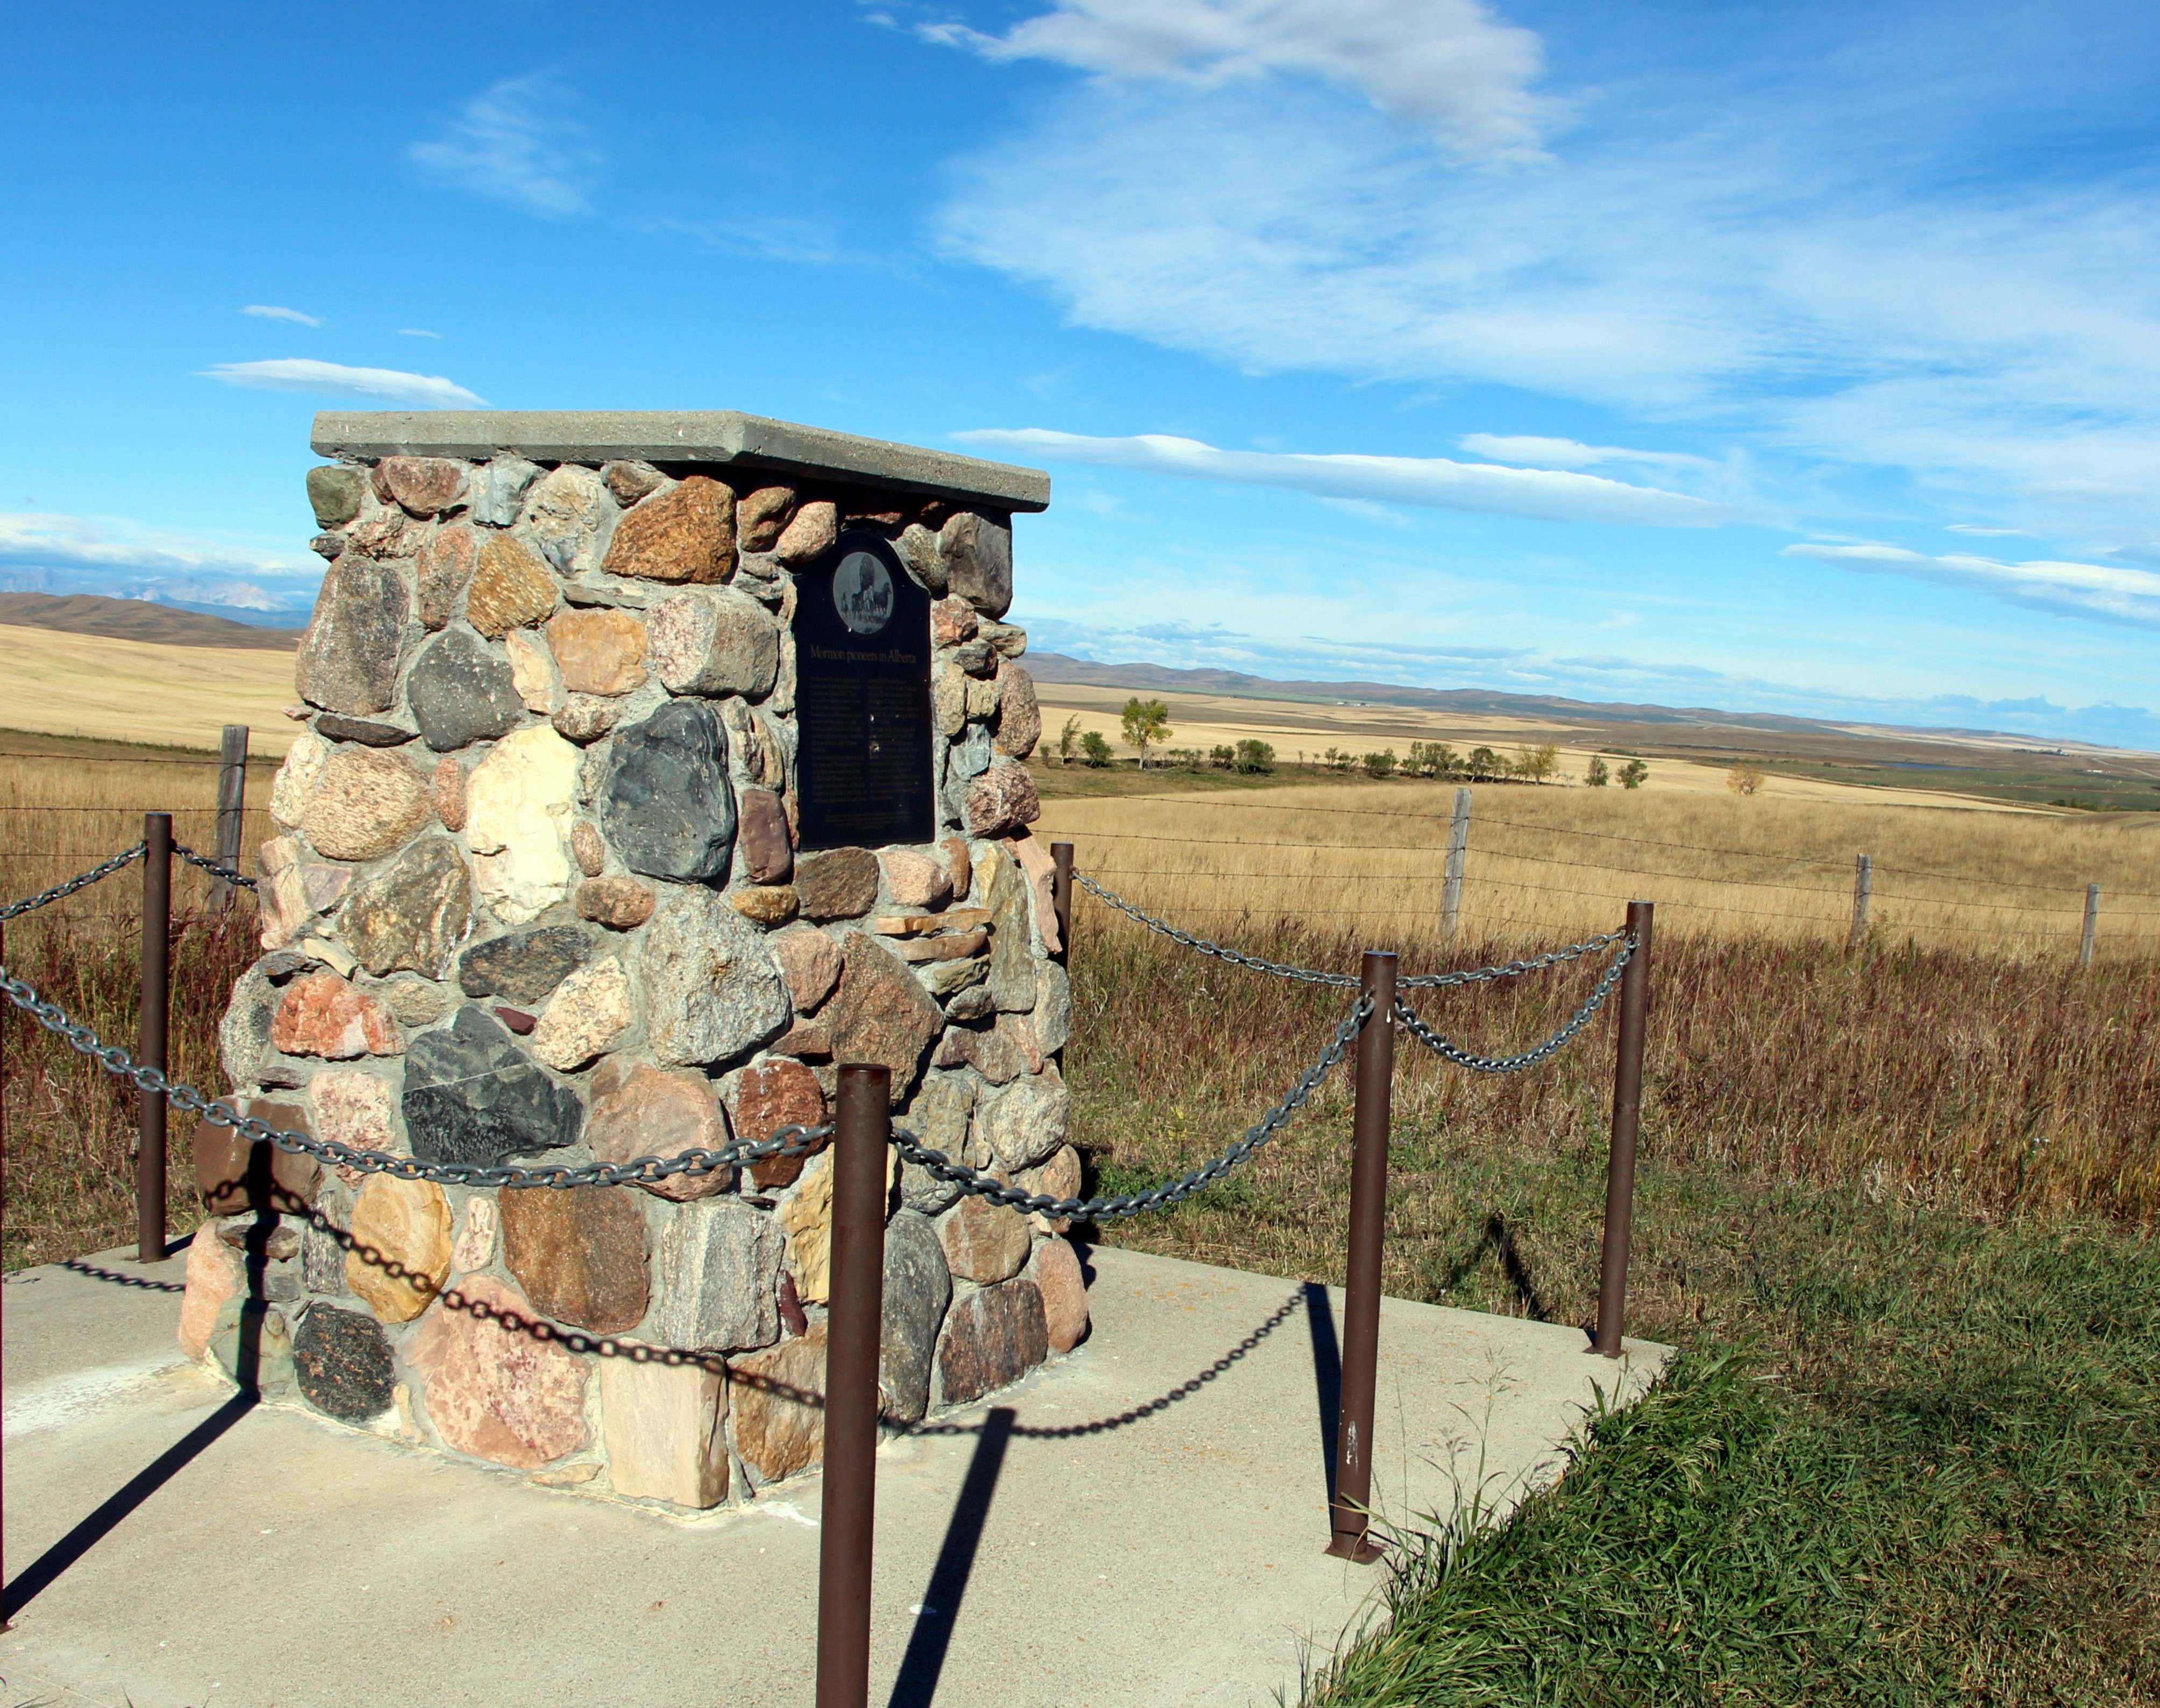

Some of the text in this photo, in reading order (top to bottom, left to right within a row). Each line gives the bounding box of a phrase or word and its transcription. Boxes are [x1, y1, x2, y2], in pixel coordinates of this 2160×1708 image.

[810, 644, 916, 663] Mormon pioneers in Alberta
